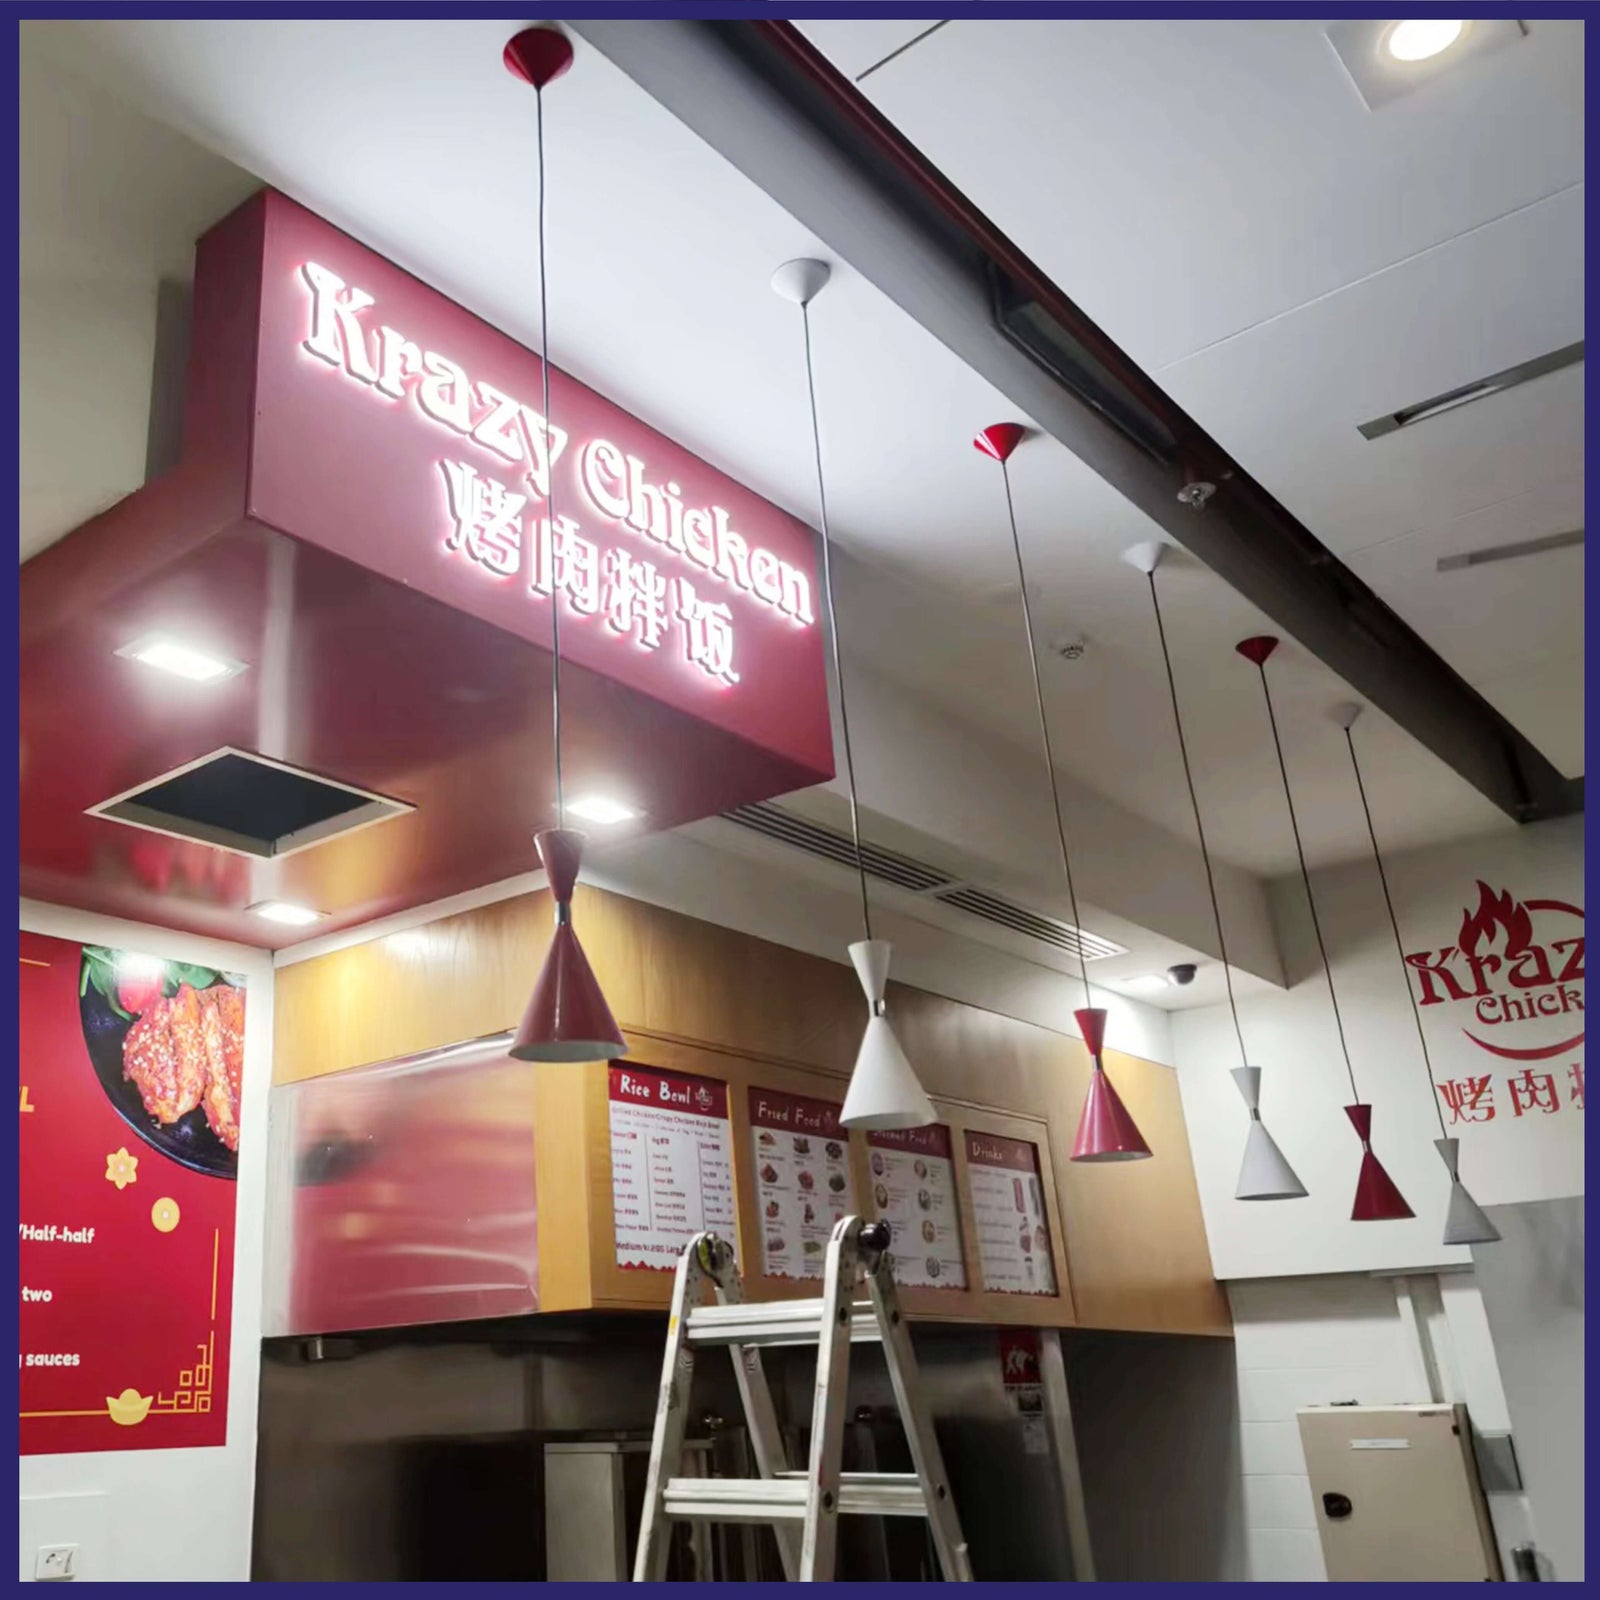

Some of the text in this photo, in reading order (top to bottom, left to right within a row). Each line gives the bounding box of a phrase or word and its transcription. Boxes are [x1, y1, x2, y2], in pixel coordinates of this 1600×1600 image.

[299, 261, 815, 626] Krazy Chicken
[437, 459, 740, 686] 烤肉拌饭
[1475, 984, 1585, 1025] Chick
[620, 1073, 651, 1098] Rice
[659, 1080, 691, 1105] Bowl
[758, 1100, 821, 1127] Fried Food
[971, 1141, 1003, 1161] Drinks
[22, 1286, 53, 1302] two
[25, 1353, 81, 1366] sauces
